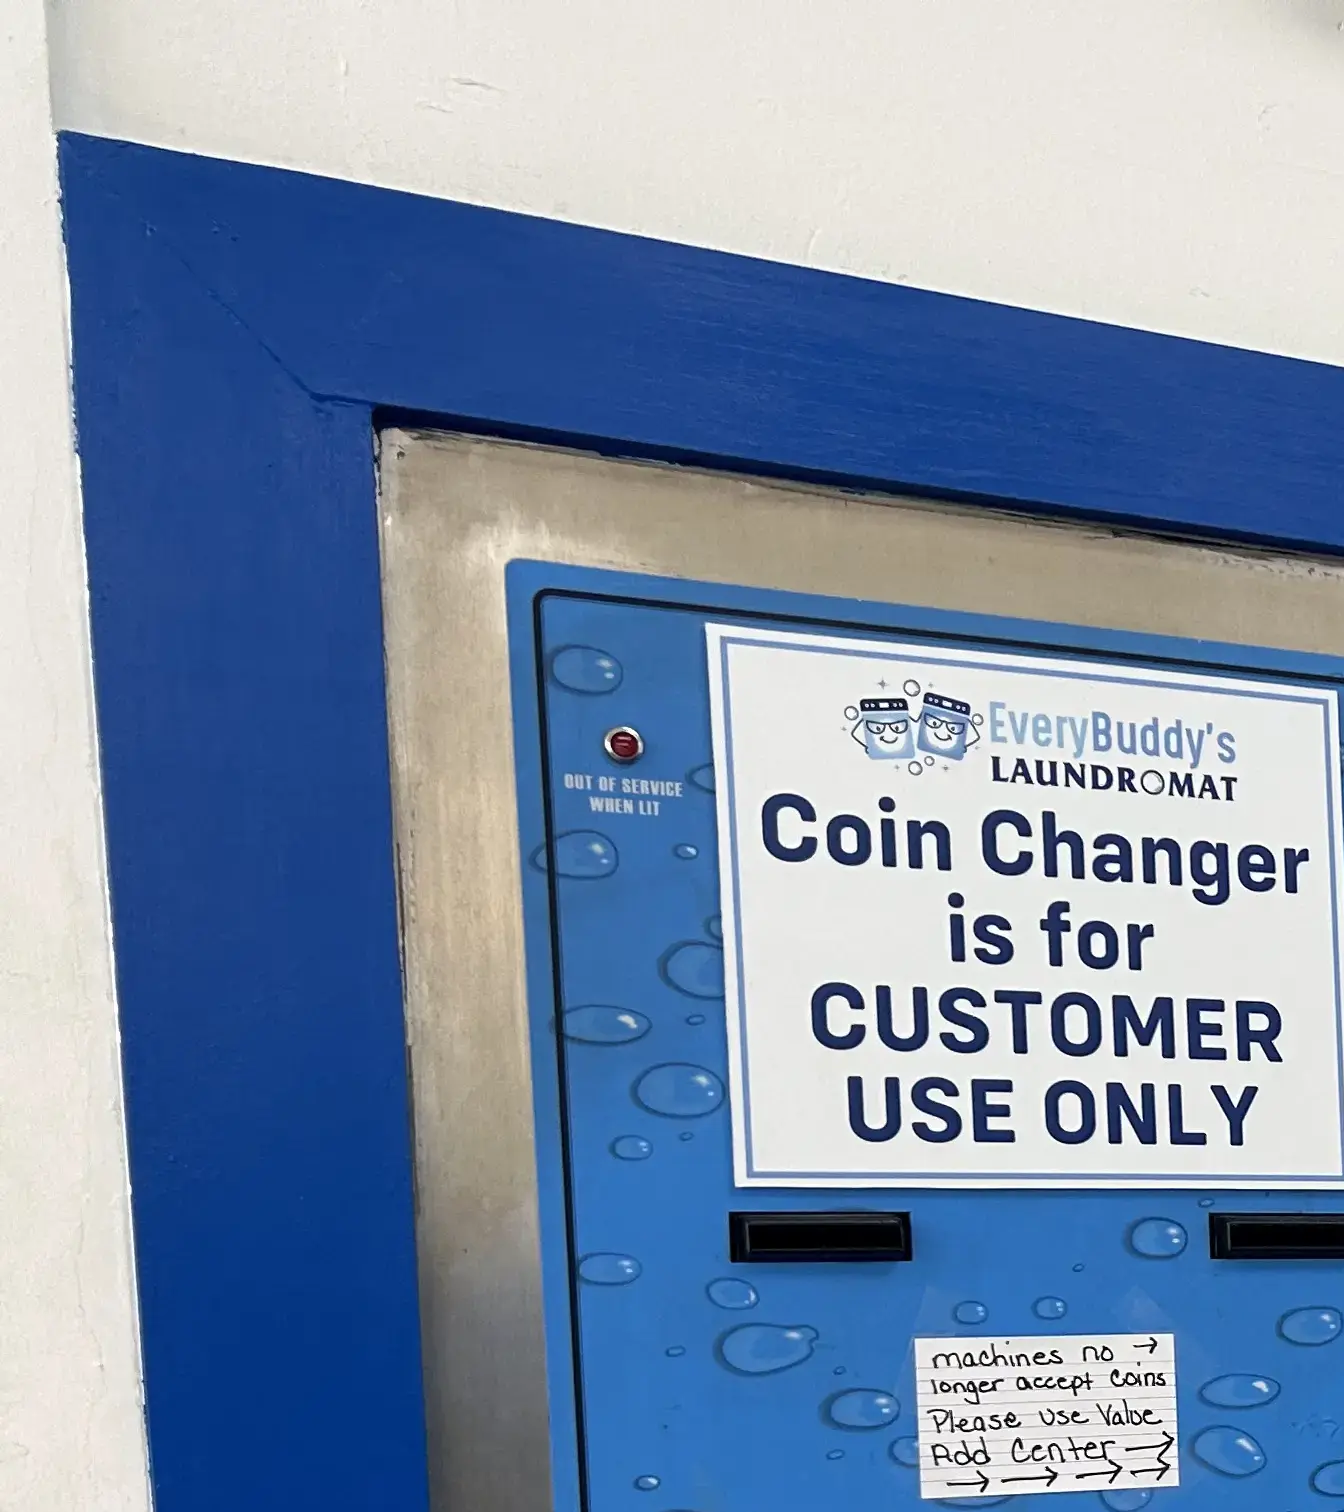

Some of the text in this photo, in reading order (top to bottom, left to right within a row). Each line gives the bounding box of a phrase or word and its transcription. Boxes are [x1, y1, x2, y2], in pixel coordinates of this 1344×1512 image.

[989, 701, 1237, 769] EveryBuddy's
[564, 773, 683, 797] OUT OF SERVICE
[990, 756, 1238, 801] LAUNDROMAT
[589, 796, 661, 816] WHEN LIT
[760, 793, 1309, 905] Coin Changer
[948, 893, 1155, 971] is for
[811, 982, 1283, 1063] CUSTOMER
[846, 1075, 1259, 1147] USE ONLY
[932, 1341, 1114, 1370] machines no
[930, 1378, 1005, 1405] longer
[1016, 1370, 1093, 1400] accept
[927, 1408, 1023, 1434] Please
[1096, 1399, 1163, 1427] Value
[930, 1436, 1116, 1466] Add Center
